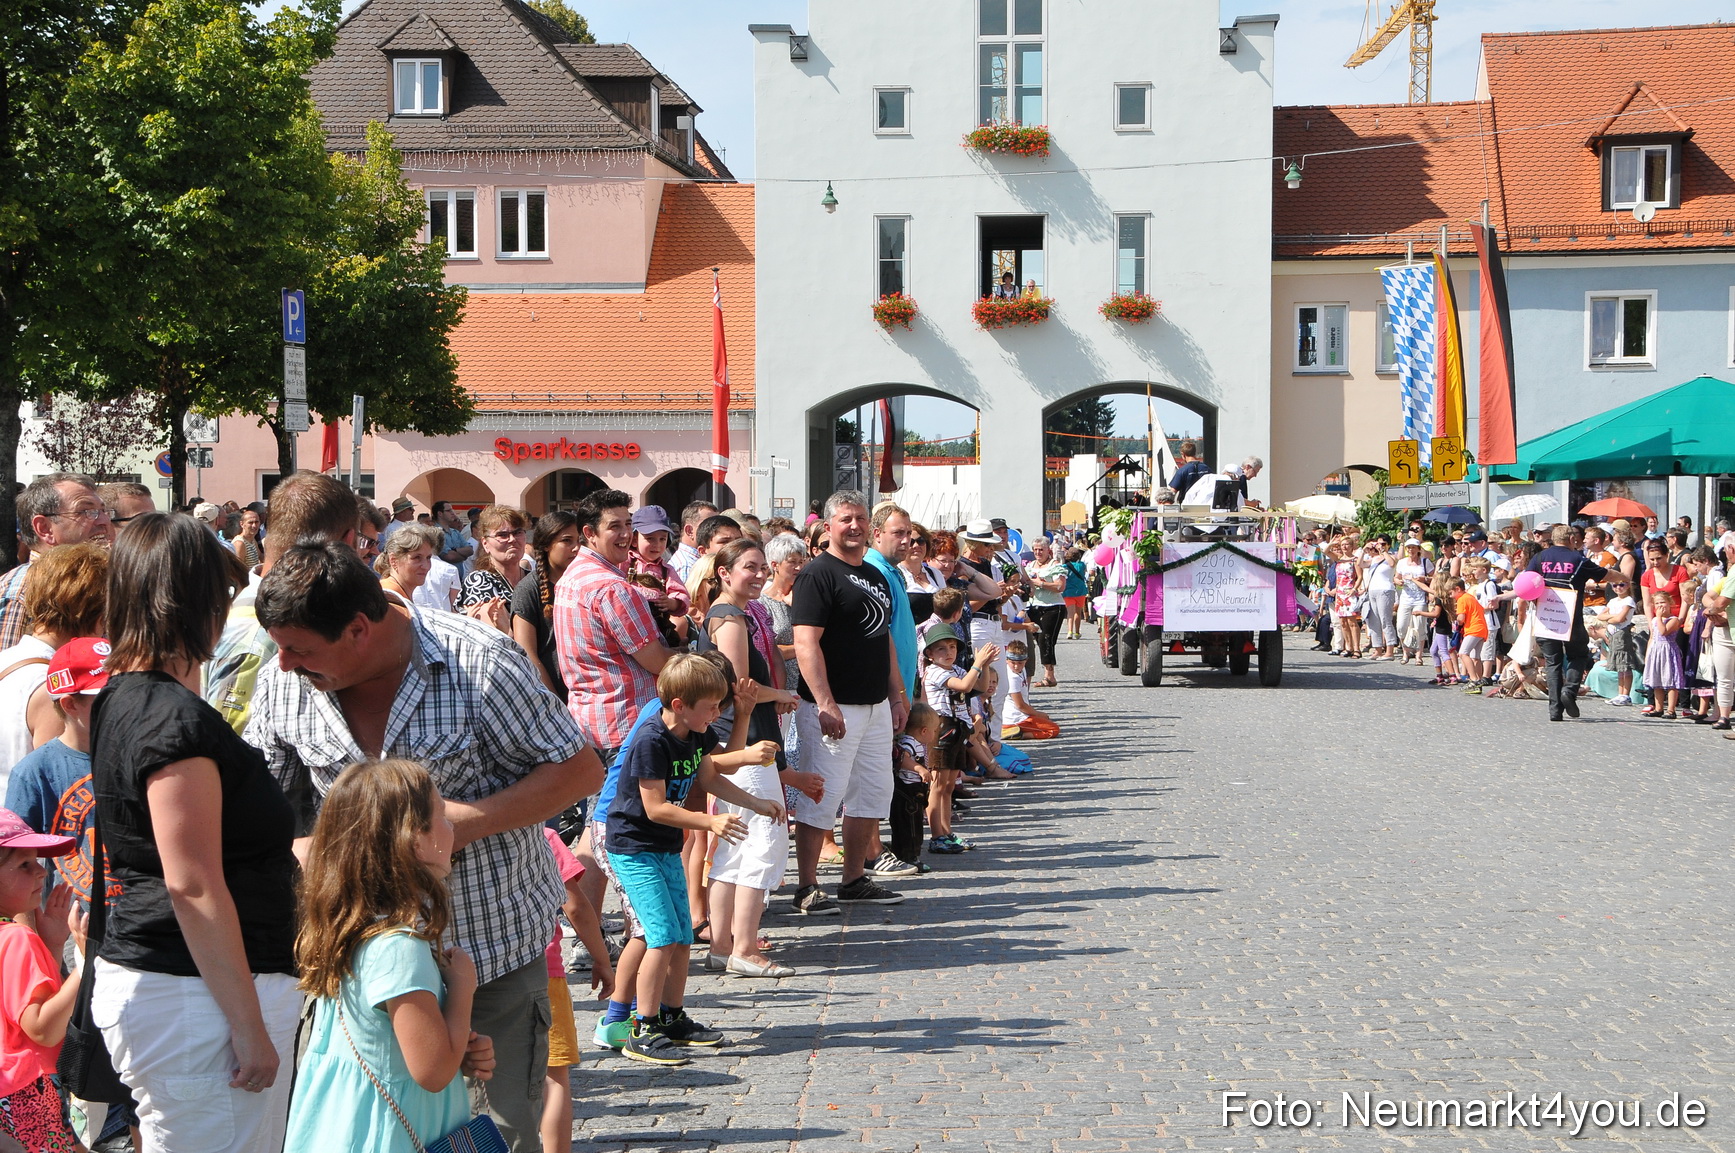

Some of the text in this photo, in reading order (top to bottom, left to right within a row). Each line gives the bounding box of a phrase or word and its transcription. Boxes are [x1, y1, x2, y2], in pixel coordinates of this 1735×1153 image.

[288, 295, 300, 336] P
[494, 437, 641, 464] Sparkasse
[1386, 494, 1416, 502] Nürnberger
[1429, 491, 1456, 499] Altdorfer
[1202, 554, 1235, 568] 2016
[1541, 561, 1575, 574] KAB
[1195, 571, 1245, 588] 125 Jahre
[849, 574, 891, 609] adidas
[1189, 589, 1257, 605] KAB Neumarkt
